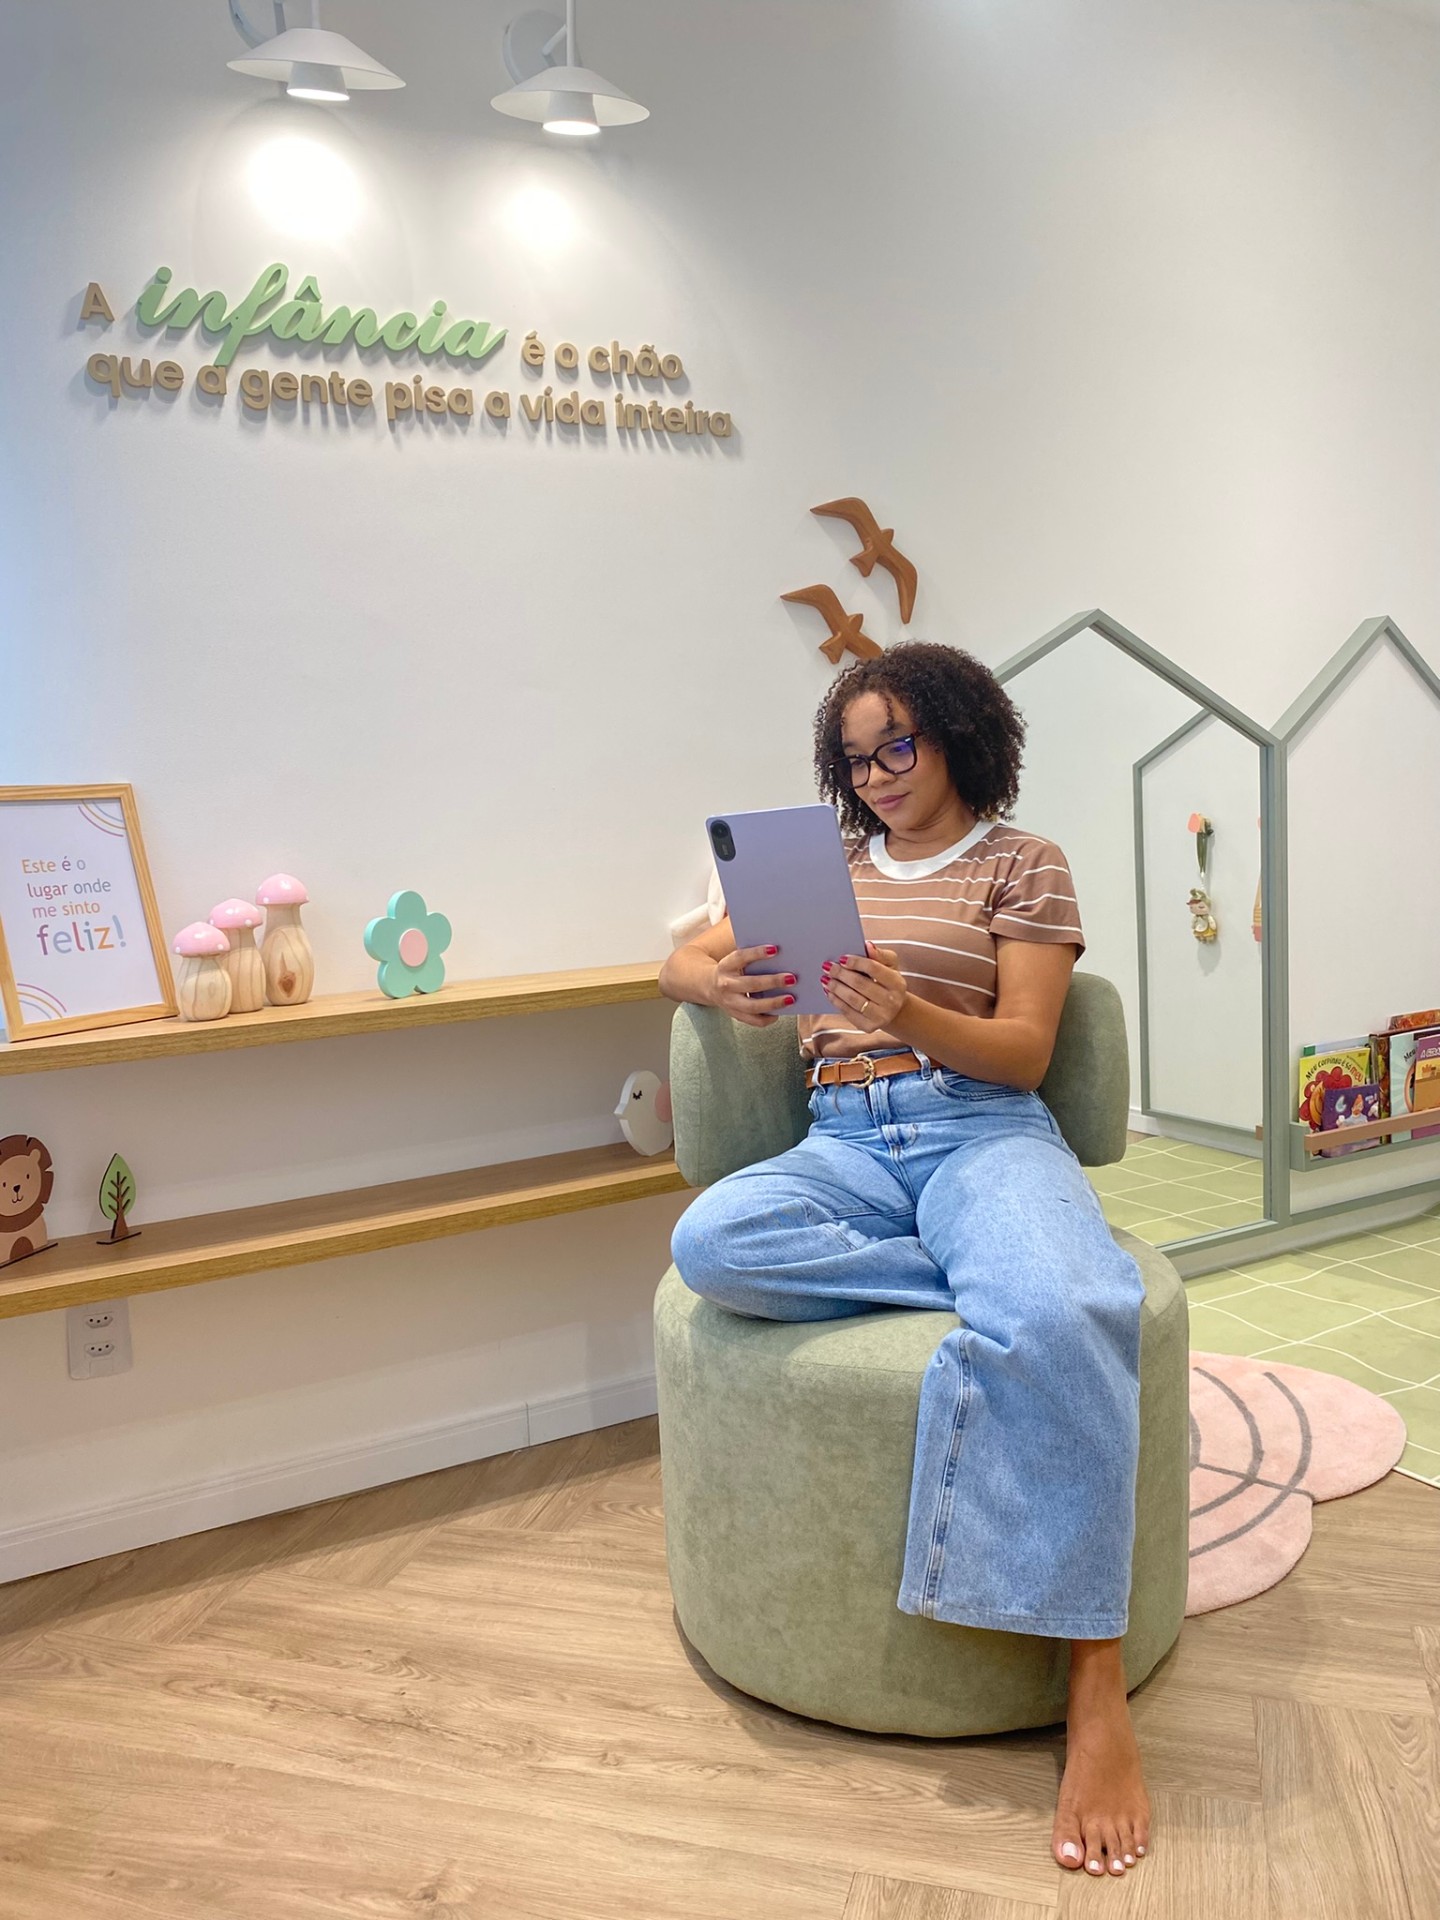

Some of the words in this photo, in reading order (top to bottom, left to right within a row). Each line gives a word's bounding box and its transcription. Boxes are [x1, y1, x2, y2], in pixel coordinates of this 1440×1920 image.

[80, 282, 114, 321] A
[137, 262, 509, 366] infância
[521, 330, 546, 366] é
[554, 342, 579, 368] o
[588, 340, 683, 379] chão
[87, 352, 184, 398] que
[197, 364, 227, 395] a
[240, 368, 373, 411] gente
[385, 375, 473, 420] pisa
[485, 390, 510, 418] a
[520, 386, 606, 425] vida
[615, 393, 732, 437] inteira
[21, 858, 56, 874] Este
[61, 856, 71, 872] é
[76, 858, 86, 871] o
[27, 882, 68, 900] lugar
[73, 879, 111, 894] onde
[32, 904, 57, 918] me
[62, 900, 100, 917] sinto
[36, 914, 127, 956] feliz!
